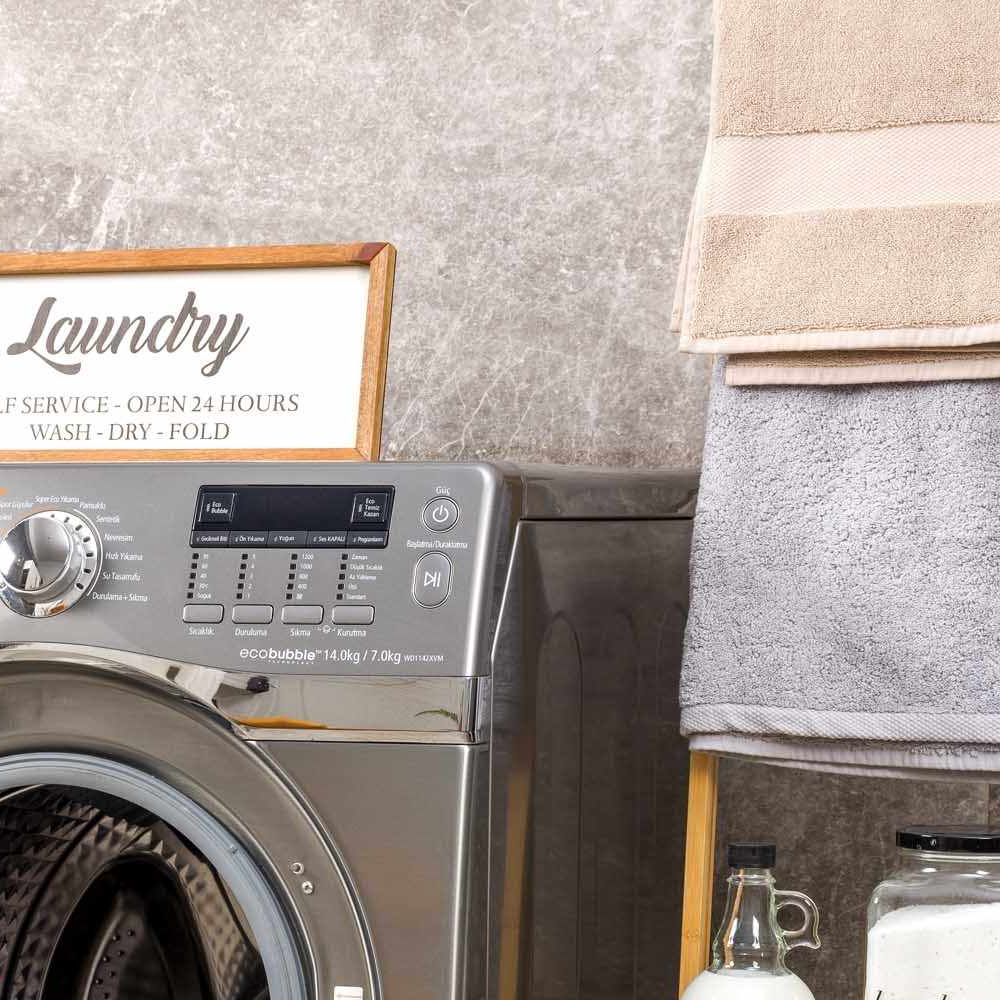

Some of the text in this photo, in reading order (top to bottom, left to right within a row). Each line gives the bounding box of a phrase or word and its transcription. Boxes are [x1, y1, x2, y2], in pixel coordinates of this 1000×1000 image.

[6, 291, 250, 377] Laundry
[21, 395, 109, 414] SERVICE
[127, 395, 187, 413] OPEN
[191, 395, 215, 413] 24
[219, 394, 300, 413] HOURS
[30, 423, 91, 441] WASH
[108, 423, 152, 441] DRY
[169, 422, 230, 441] FOLD
[324, 648, 360, 664] 14.0kg
[370, 649, 401, 665] 7.0kg
